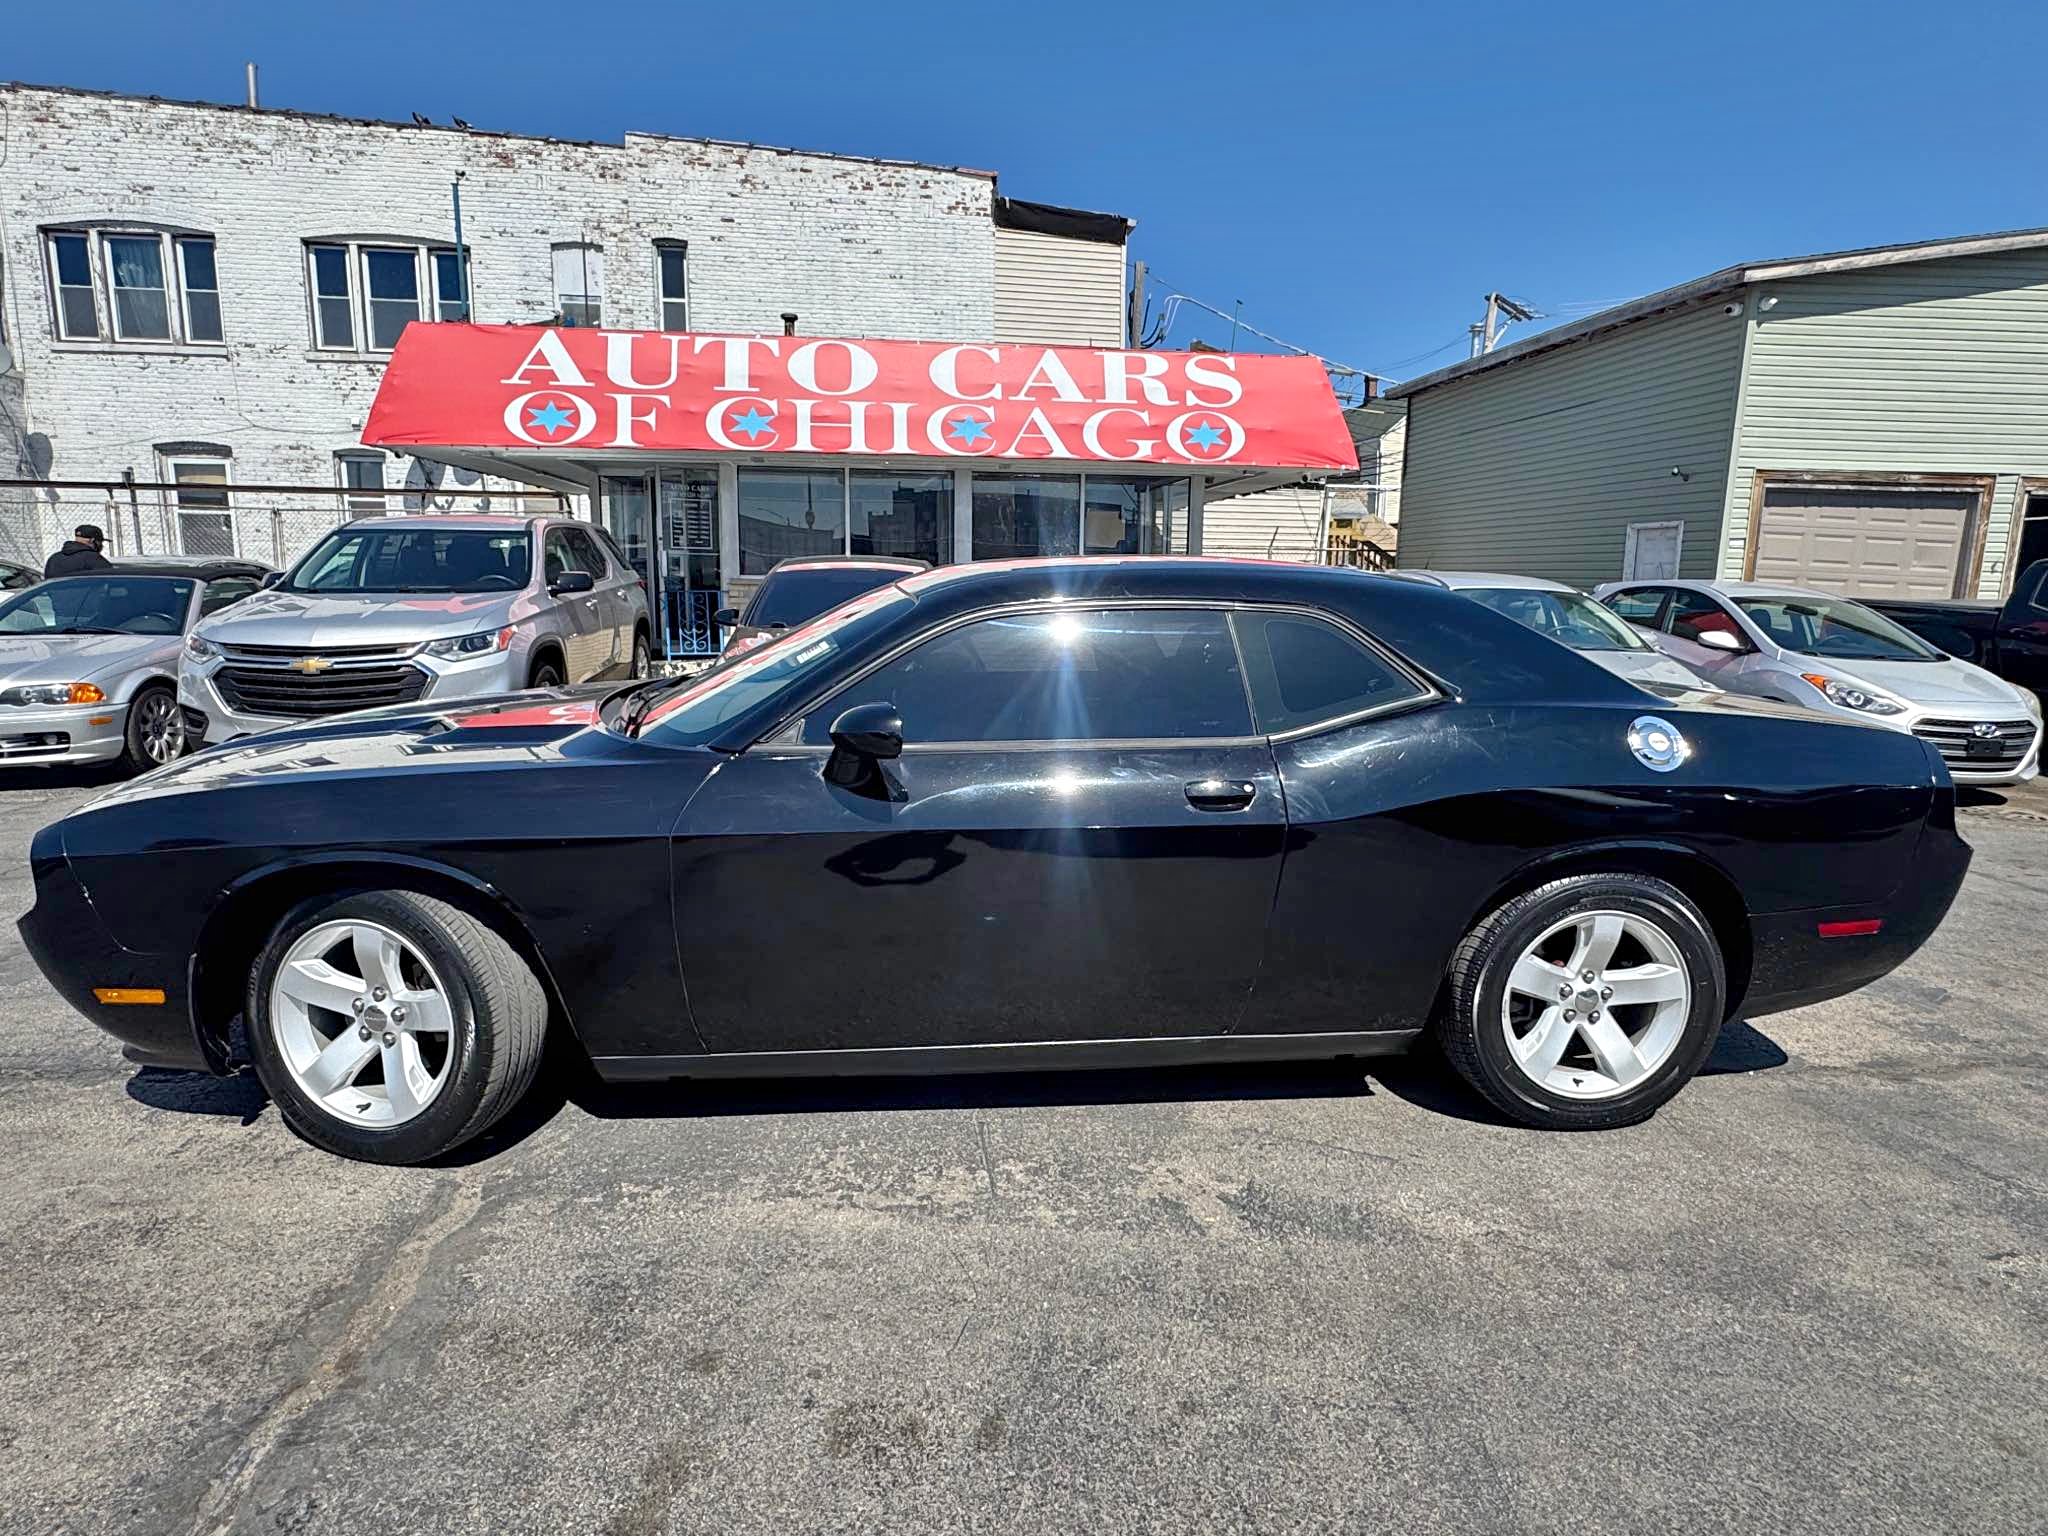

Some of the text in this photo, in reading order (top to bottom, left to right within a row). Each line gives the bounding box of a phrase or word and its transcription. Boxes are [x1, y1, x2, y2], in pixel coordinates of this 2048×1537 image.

[501, 329, 1243, 408] AUTO CARS
[504, 391, 1246, 464] OF CHICAGO
